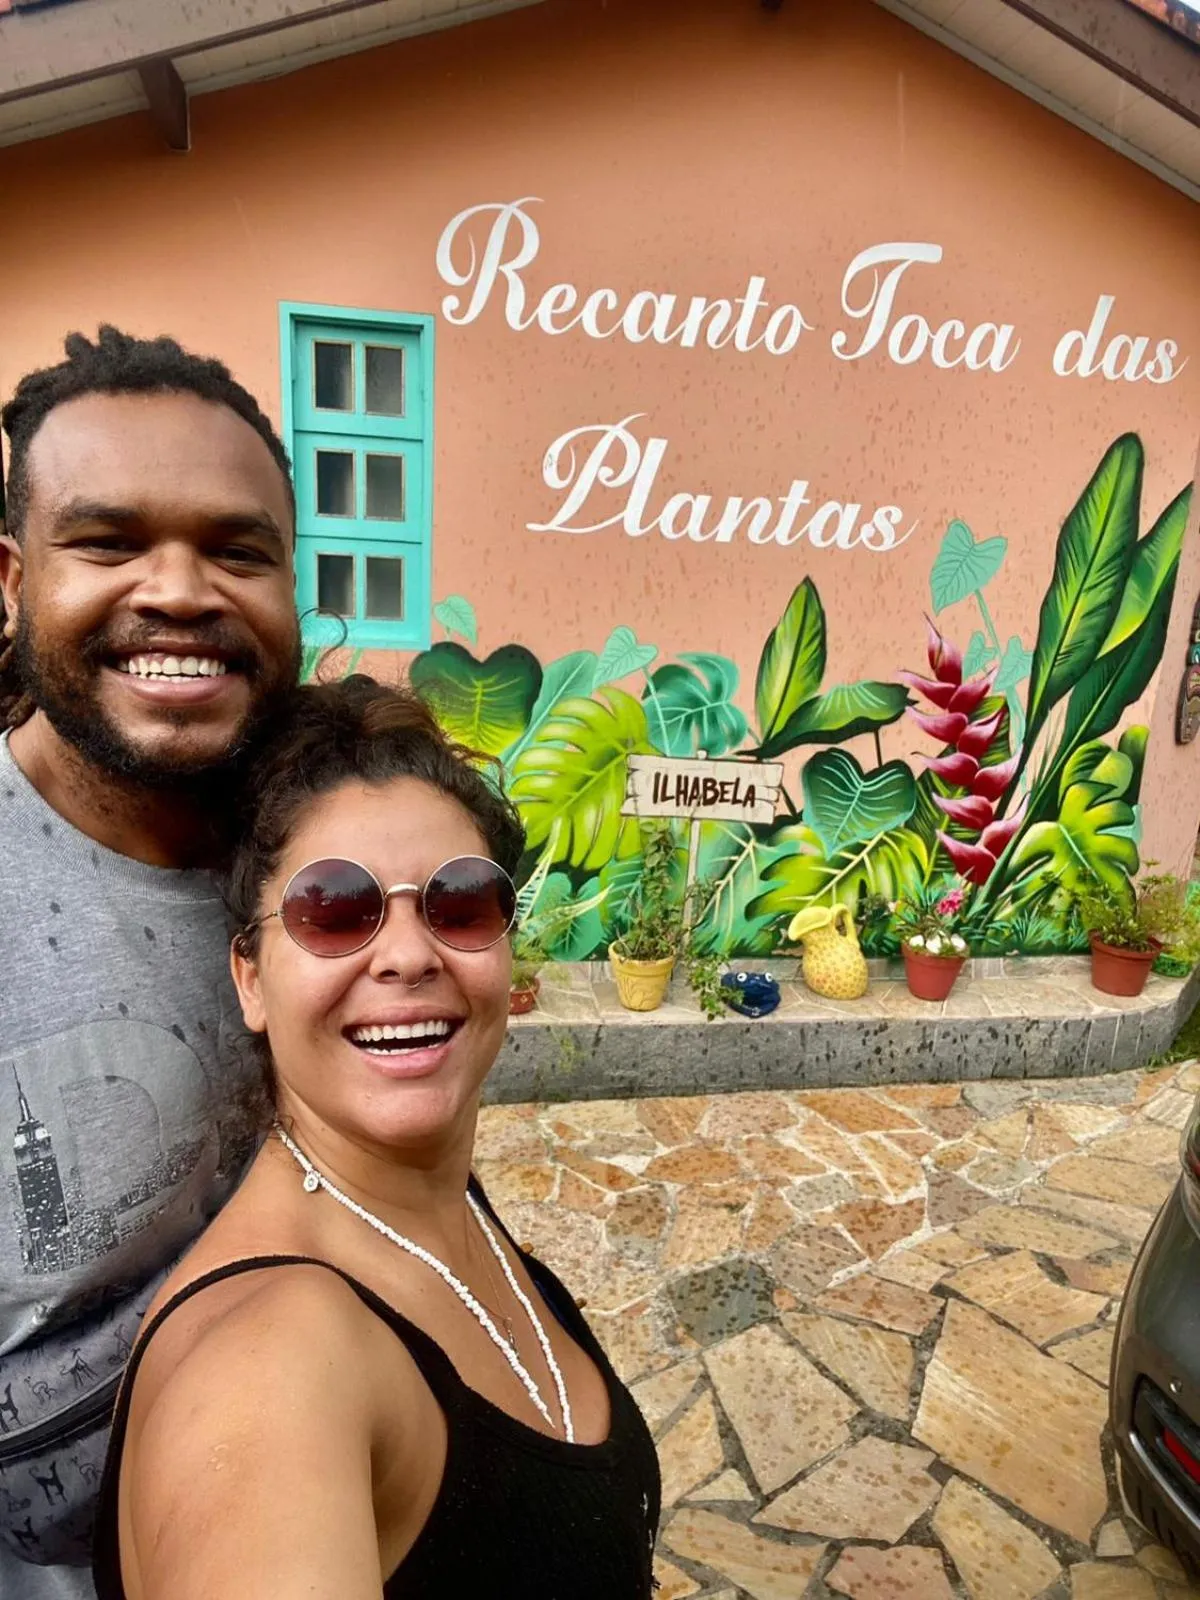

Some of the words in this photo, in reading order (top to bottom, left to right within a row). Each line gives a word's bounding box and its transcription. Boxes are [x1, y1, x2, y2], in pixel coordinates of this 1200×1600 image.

[436, 196, 815, 355] Recanto
[831, 242, 1021, 373] Toca
[1052, 294, 1189, 384] das
[526, 412, 919, 552] Plantas
[652, 771, 757, 809] ILHABELA
